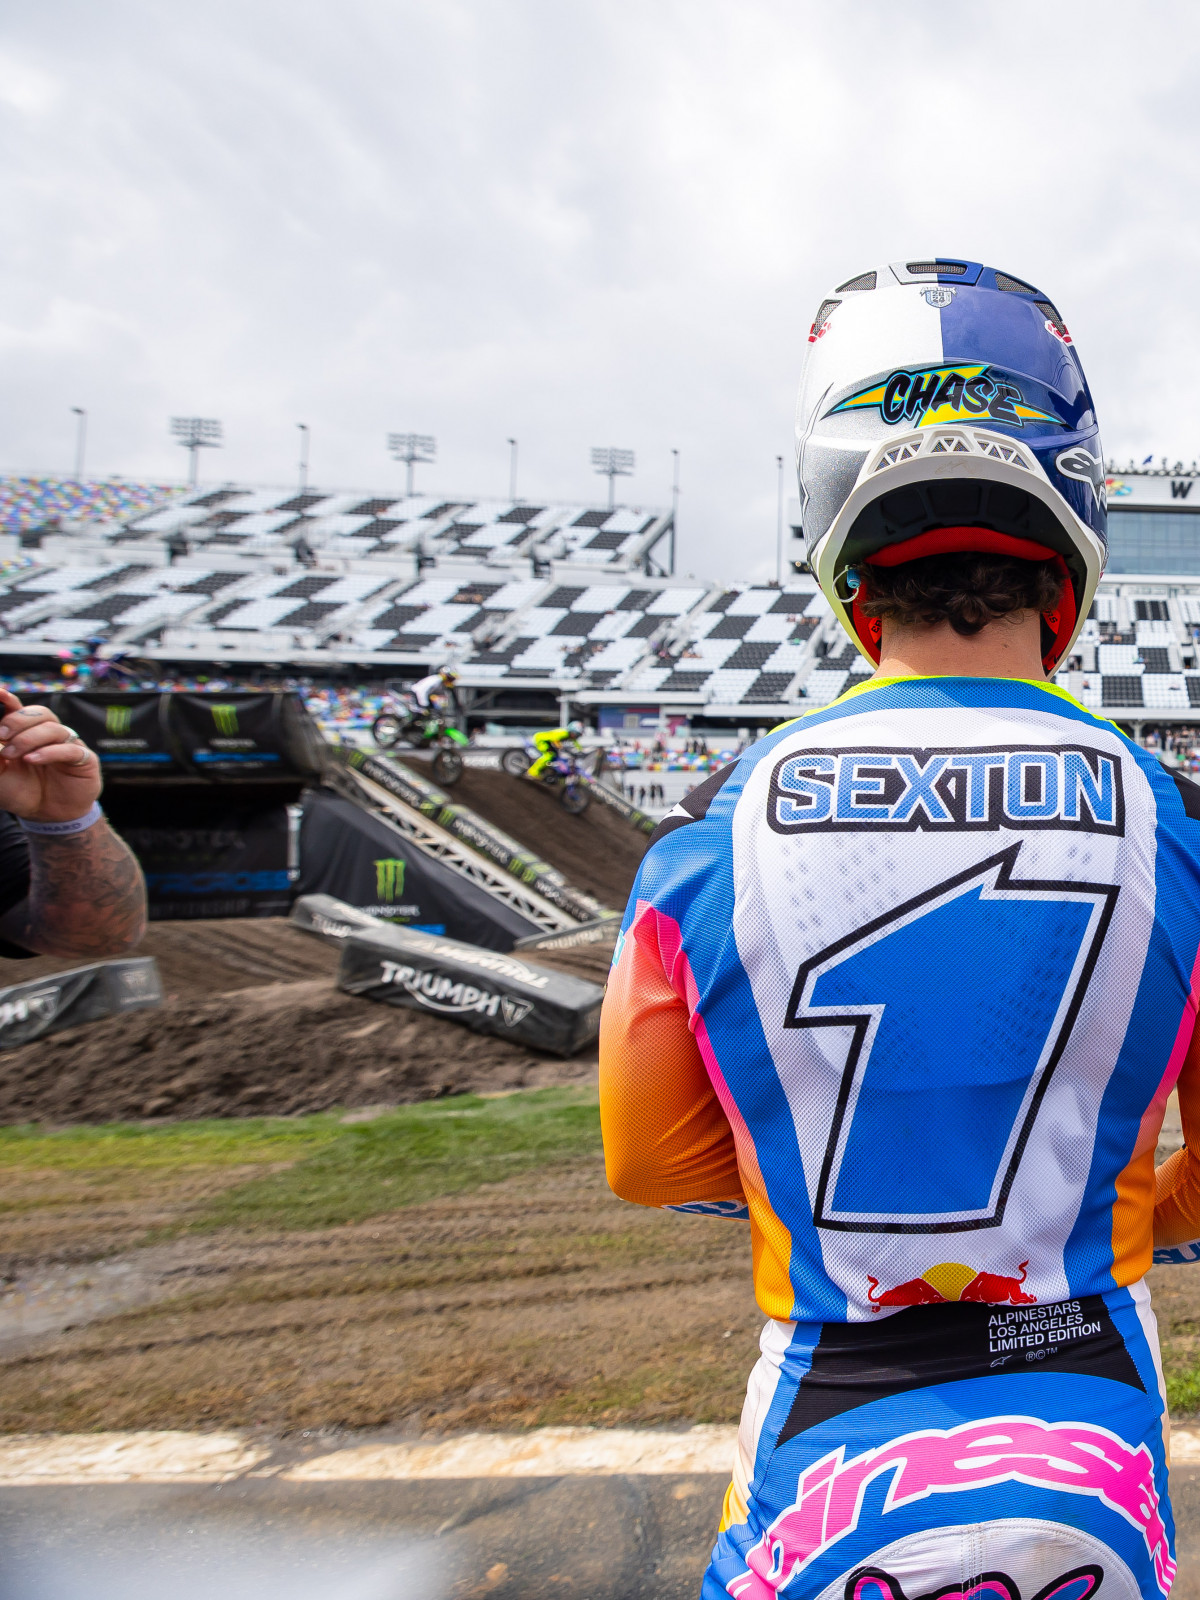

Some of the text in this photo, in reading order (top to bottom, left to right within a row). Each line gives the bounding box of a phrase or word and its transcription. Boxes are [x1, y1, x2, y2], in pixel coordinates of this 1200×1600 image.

[882, 372, 1023, 426] CHASE
[774, 751, 1117, 827] SEXTON
[380, 960, 500, 1017] TRIUMPH
[787, 842, 1120, 1234] 1
[988, 1301, 1081, 1327] ALPINESTARS
[989, 1313, 1084, 1339] LOS ANGELES
[989, 1321, 1101, 1353] LIMITED EDITION
